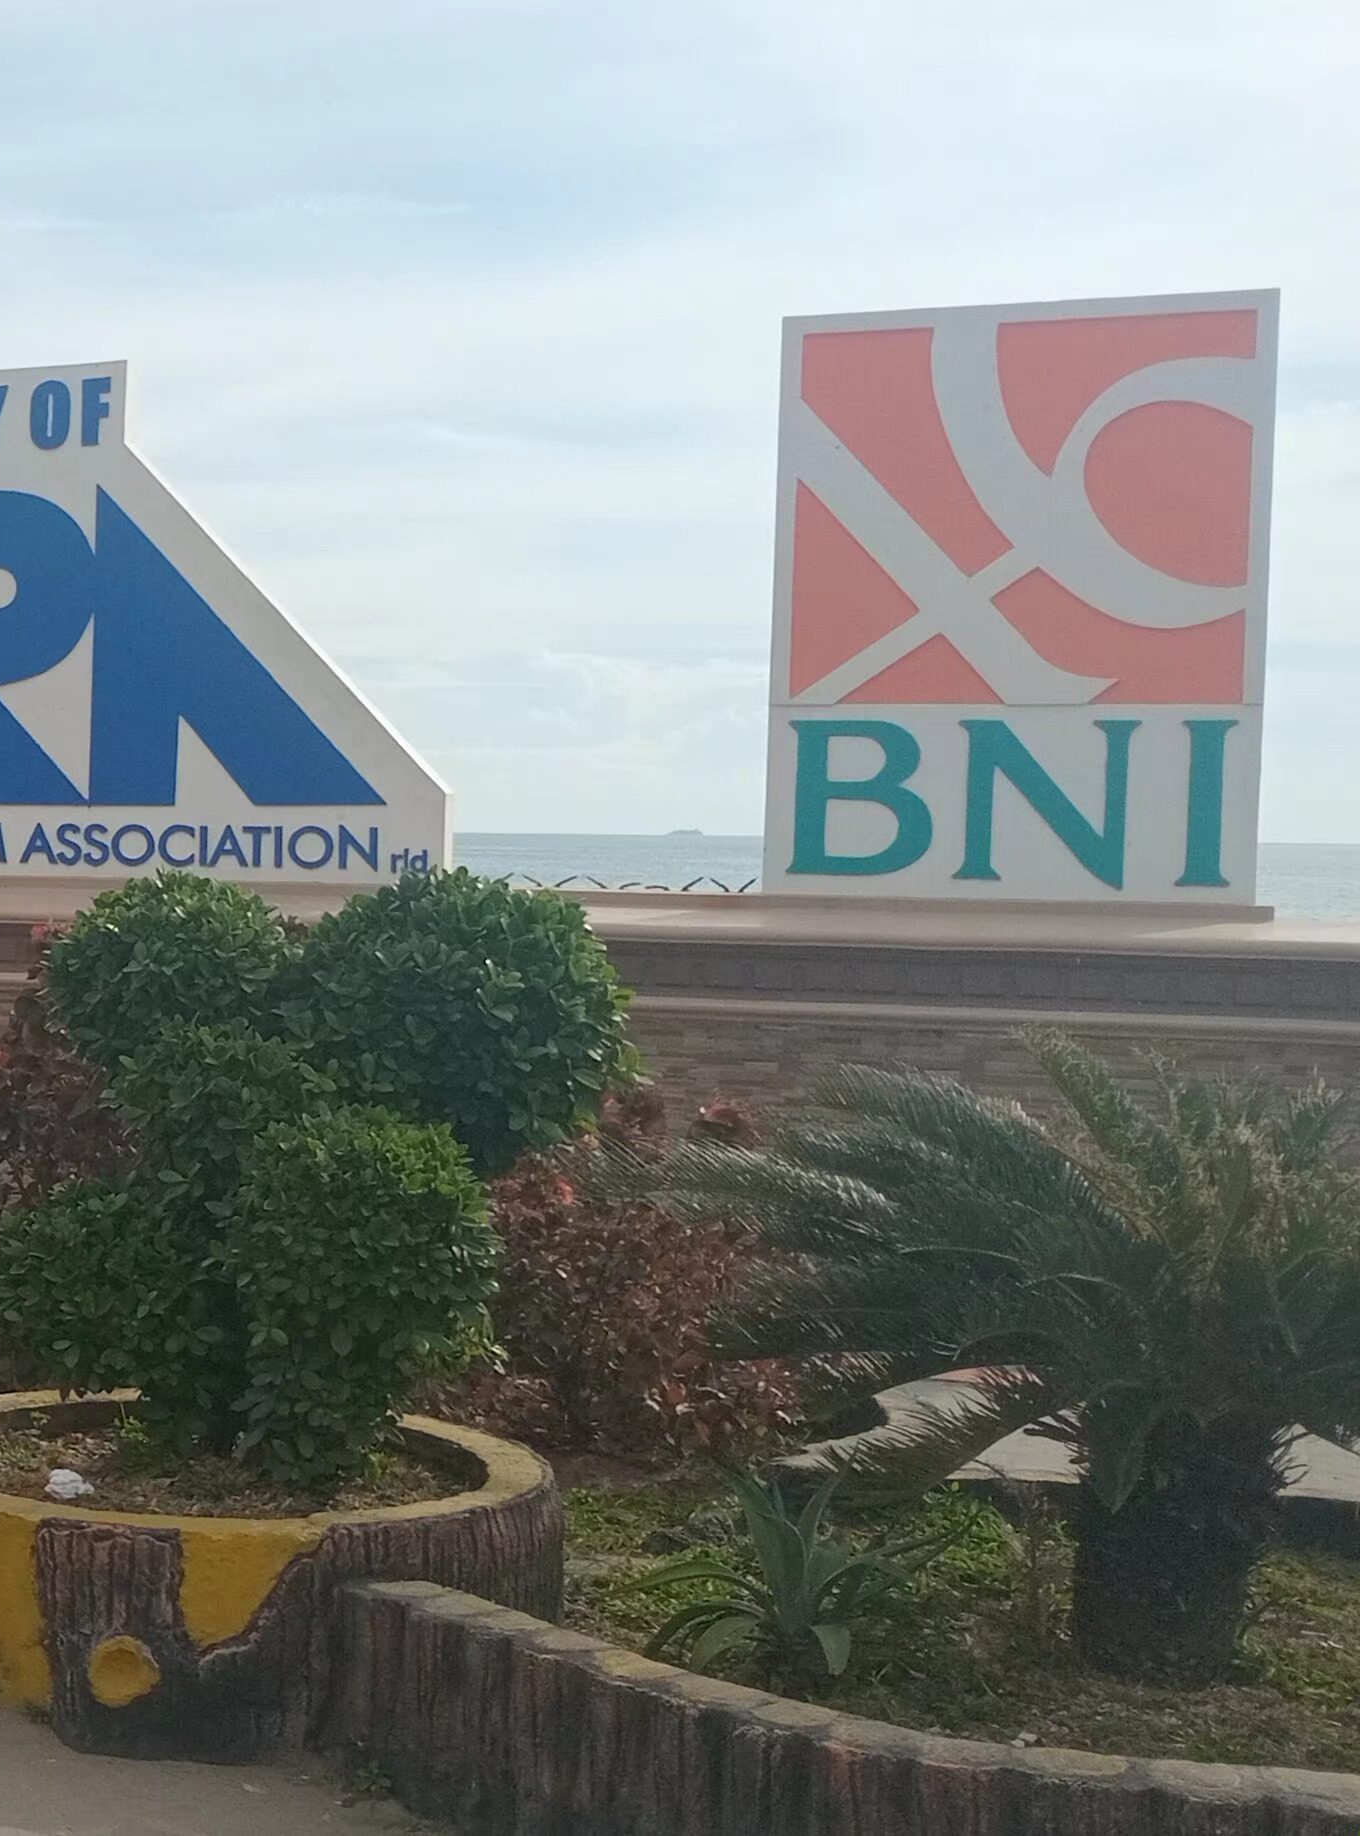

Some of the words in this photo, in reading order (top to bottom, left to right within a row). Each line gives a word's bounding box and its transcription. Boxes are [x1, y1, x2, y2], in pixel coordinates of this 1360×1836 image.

[29, 375, 112, 451] OF
[785, 718, 1240, 891] BNI
[19, 822, 379, 872] ASSOCIATION
